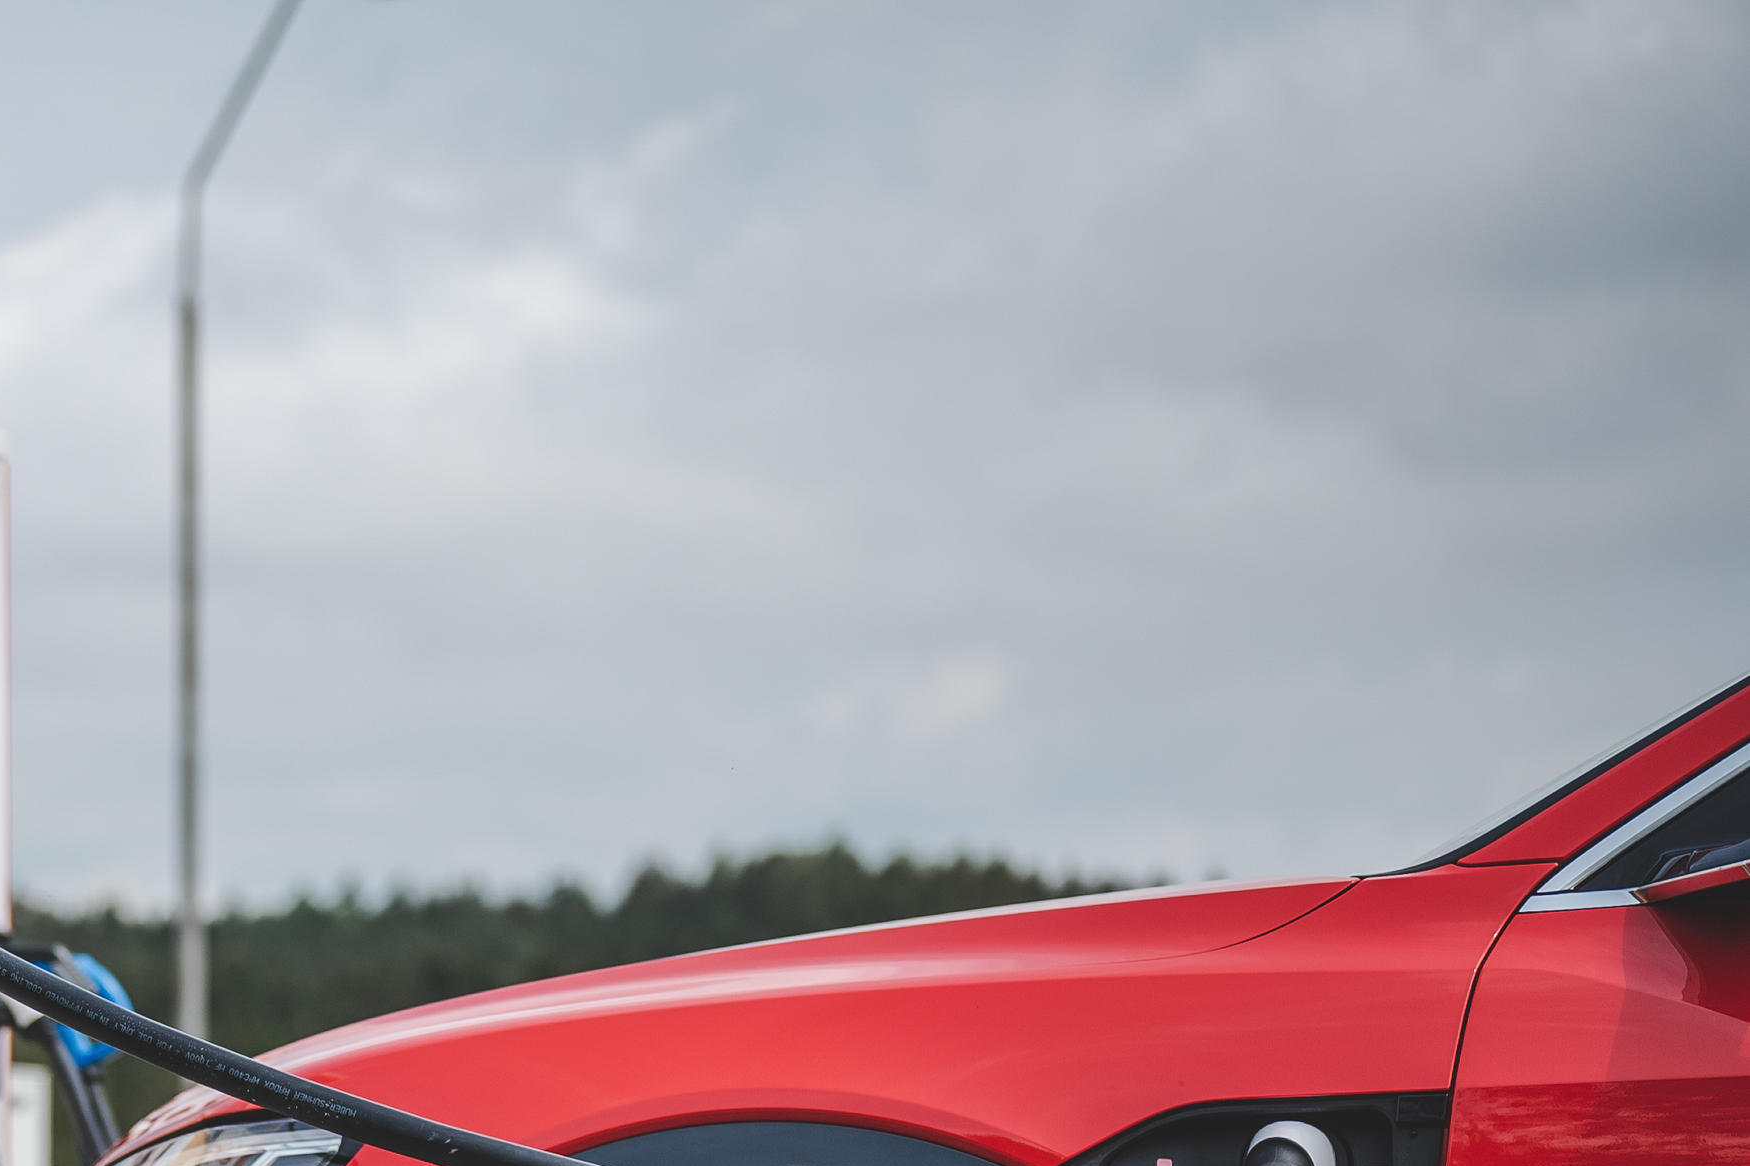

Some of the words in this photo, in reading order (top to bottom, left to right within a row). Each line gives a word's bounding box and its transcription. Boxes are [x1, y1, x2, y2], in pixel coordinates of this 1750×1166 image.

[7, 972, 44, 995] COOLING
[43, 988, 84, 1015] APPROVED
[97, 1013, 112, 1026] IN
[112, 1021, 137, 1037] ONLY
[135, 1030, 154, 1045] USE
[153, 1038, 174, 1053] FOR
[182, 1049, 212, 1068] 1000V
[213, 1060, 227, 1073] HF
[262, 1079, 291, 1097] RADOX
[291, 1090, 357, 1118] HUBER+SUHNER
